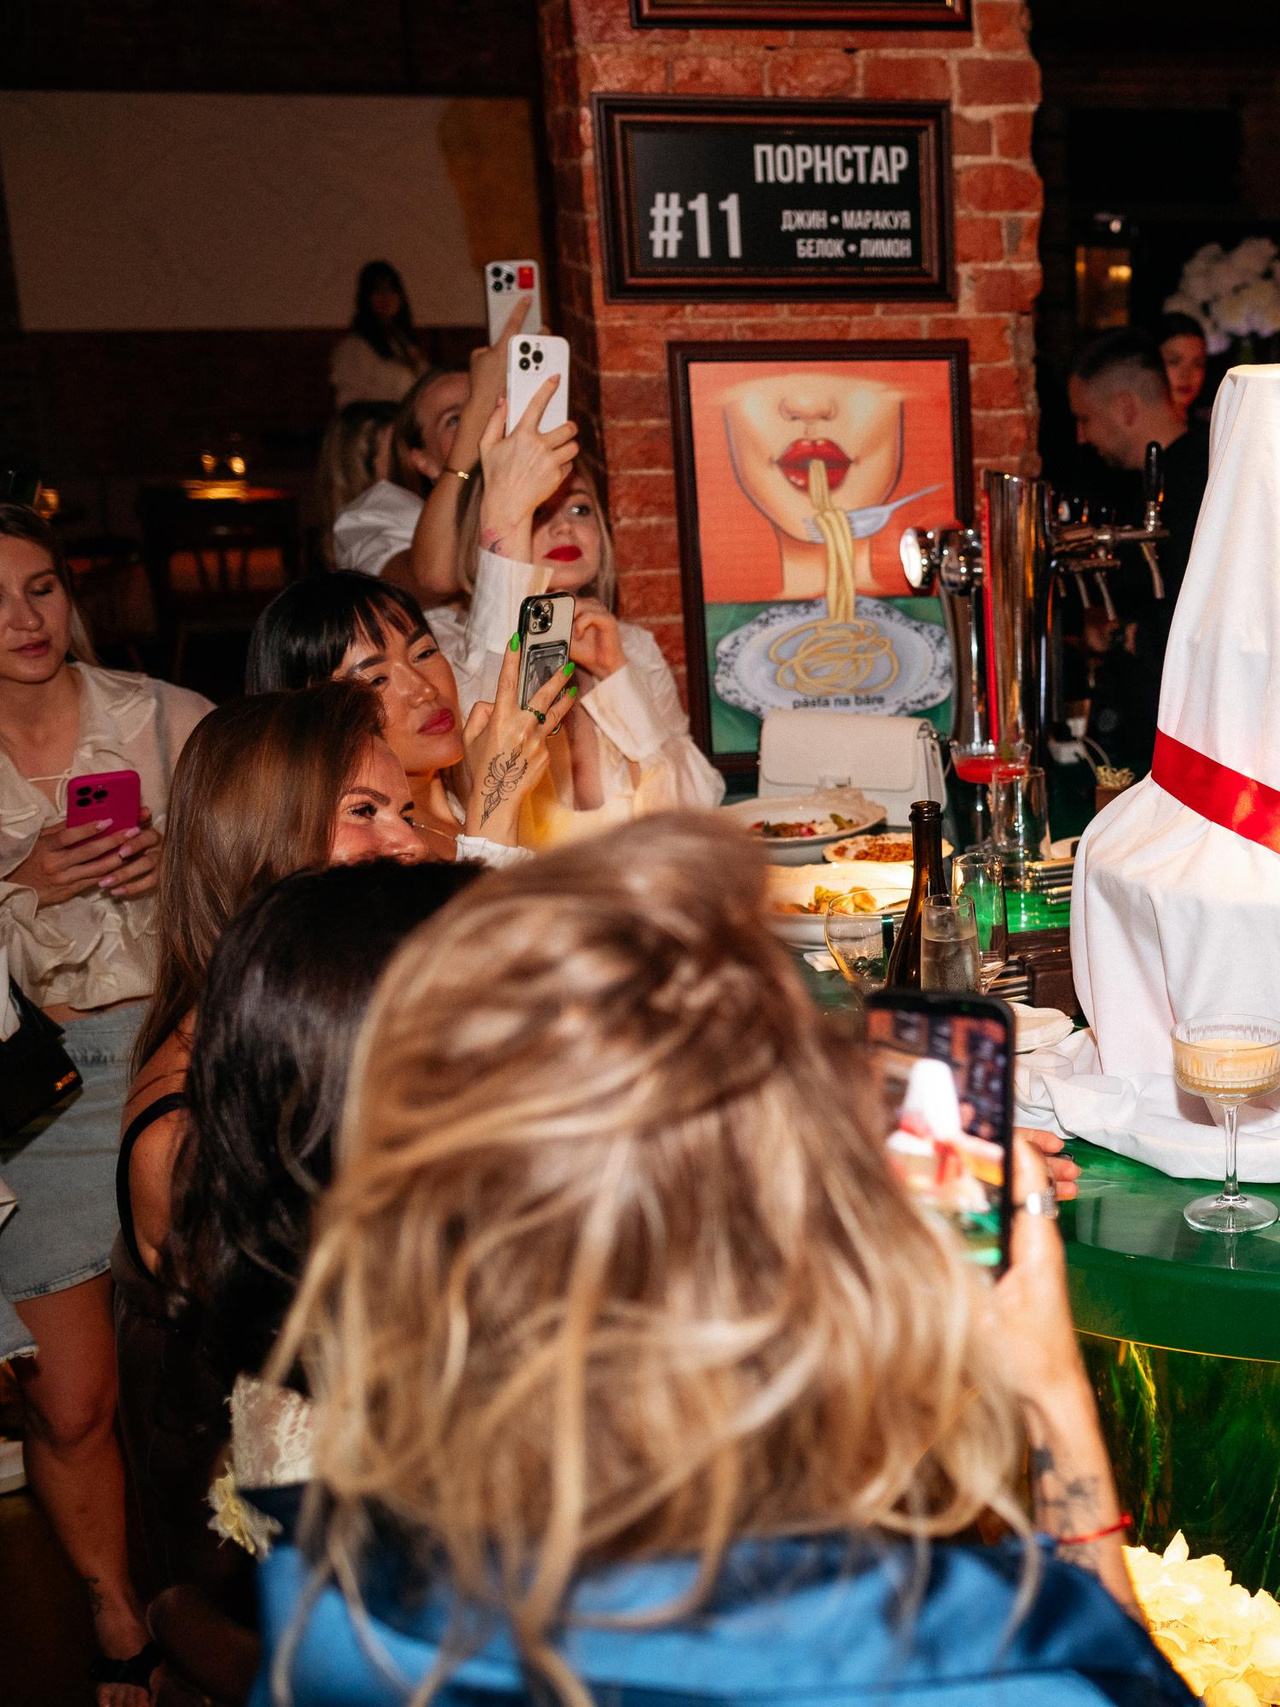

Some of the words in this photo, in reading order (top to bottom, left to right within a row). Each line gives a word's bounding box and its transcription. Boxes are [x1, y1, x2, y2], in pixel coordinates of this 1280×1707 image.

[753, 144, 909, 184] ПОРНСТАР
[648, 192, 742, 259] #11
[780, 209, 828, 231] ДЖИН
[841, 209, 911, 230] МАРАКУЯ
[796, 238, 845, 259] БЕЛОК
[859, 238, 912, 259] ЛИМОН
